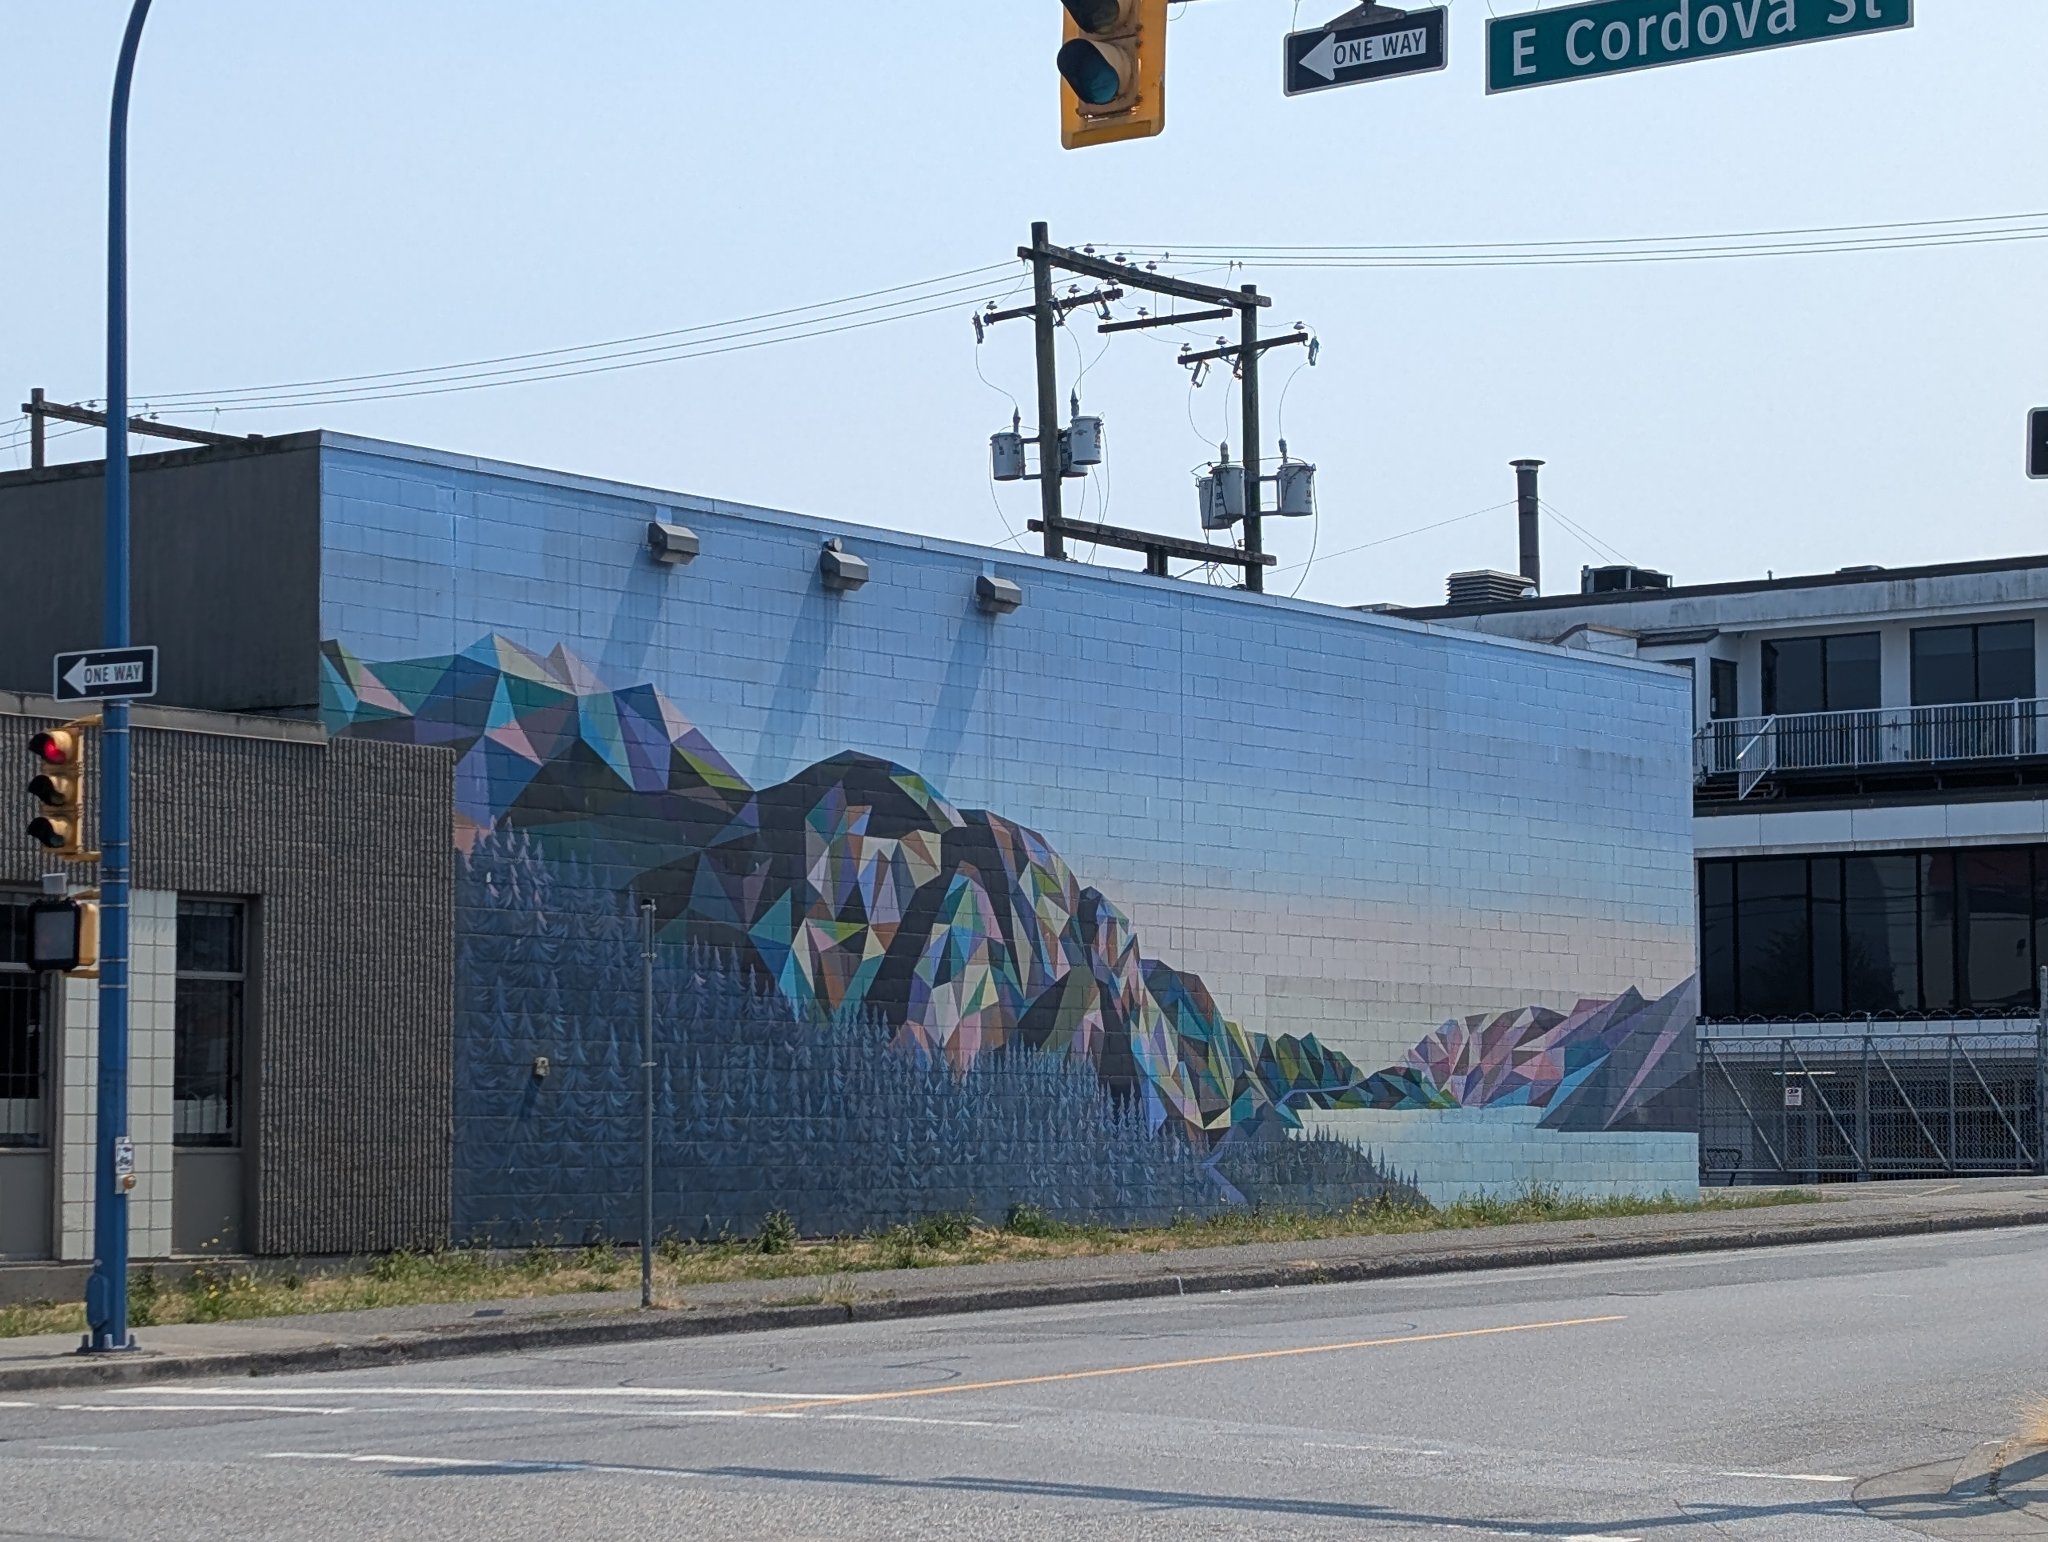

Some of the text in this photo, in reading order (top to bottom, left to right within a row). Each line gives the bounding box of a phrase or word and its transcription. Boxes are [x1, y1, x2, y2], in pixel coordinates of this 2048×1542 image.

[1334, 40, 1373, 65] ONE
[1382, 31, 1424, 57] WAY
[1513, 28, 1537, 76] E
[1565, 0, 1796, 66] Cordova
[84, 664, 140, 684] ONE WAY
